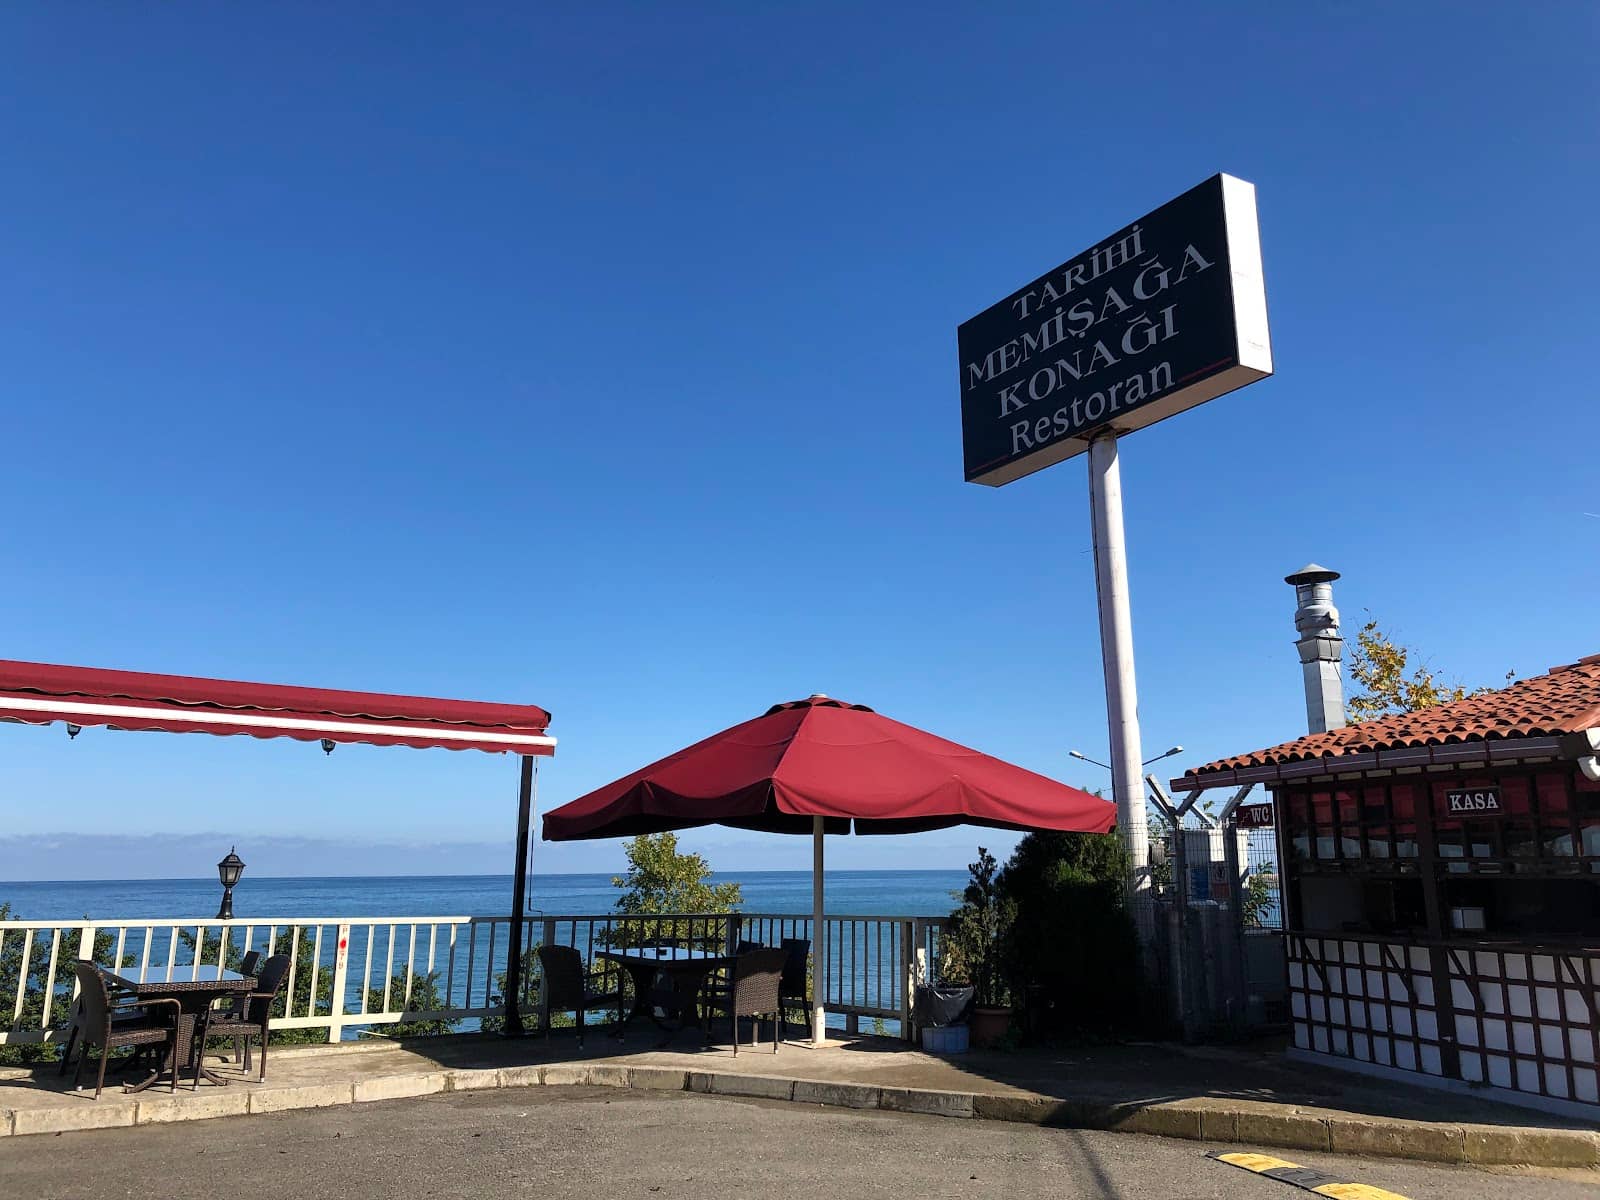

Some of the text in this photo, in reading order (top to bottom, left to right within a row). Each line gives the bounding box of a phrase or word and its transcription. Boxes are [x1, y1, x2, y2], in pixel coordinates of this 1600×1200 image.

[968, 244, 1215, 390] MEMİŞAĞA
[1013, 225, 1146, 320] TARİHİ
[998, 304, 1180, 418] KONAĞI
[1010, 361, 1175, 455] Restoran
[1250, 806, 1270, 823] WC
[1449, 792, 1499, 811] KASA
